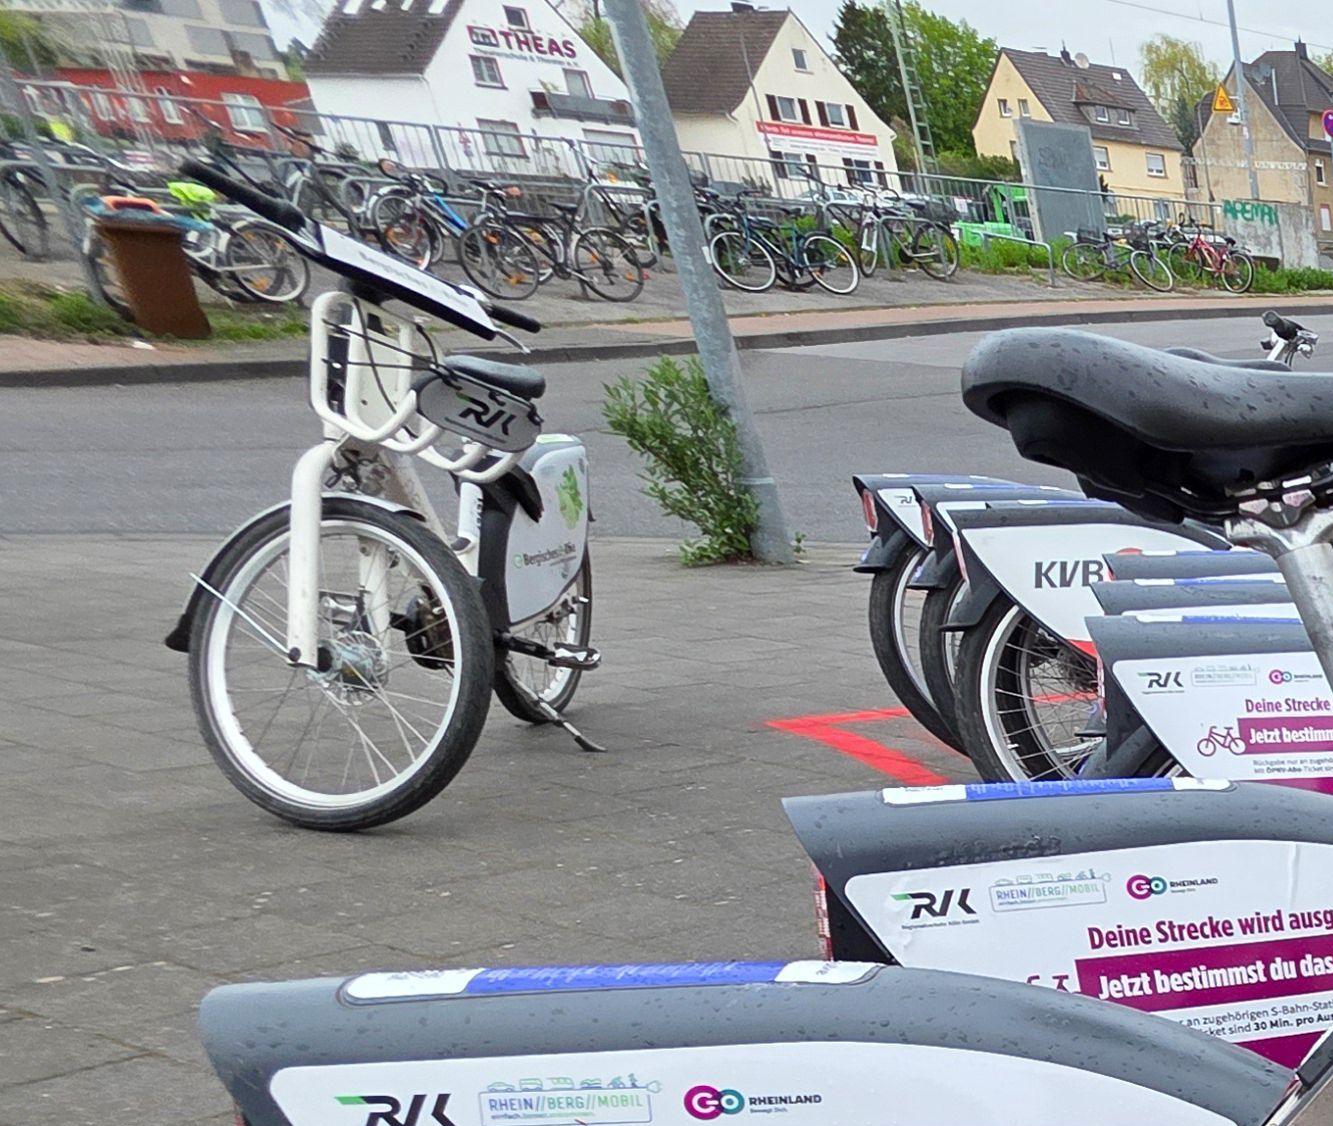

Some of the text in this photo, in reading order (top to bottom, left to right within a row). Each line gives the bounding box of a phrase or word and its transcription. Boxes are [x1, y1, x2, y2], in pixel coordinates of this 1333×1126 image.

[499, 31, 576, 58] THEAS
[1035, 560, 1104, 589] KVB
[1245, 698, 1283, 713] Deine
[1285, 697, 1331, 712] Strecke
[1249, 726, 1281, 745] Jetzt
[1087, 926, 1152, 950] Deine
[1156, 917, 1234, 944] Strecke
[1237, 910, 1284, 935] wird
[1098, 975, 1152, 999] Jetzt
[1153, 962, 1266, 994] bestimmst
[1269, 956, 1298, 980] du
[1187, 1017, 1200, 1027] an
[1202, 1009, 1269, 1026] zugehörigen
[1228, 1022, 1250, 1034] sind
[1253, 1021, 1267, 1032] 30
[1270, 1019, 1293, 1029] Min.
[1296, 1017, 1314, 1027] pro
[748, 1094, 822, 1106] RHEINLAND
